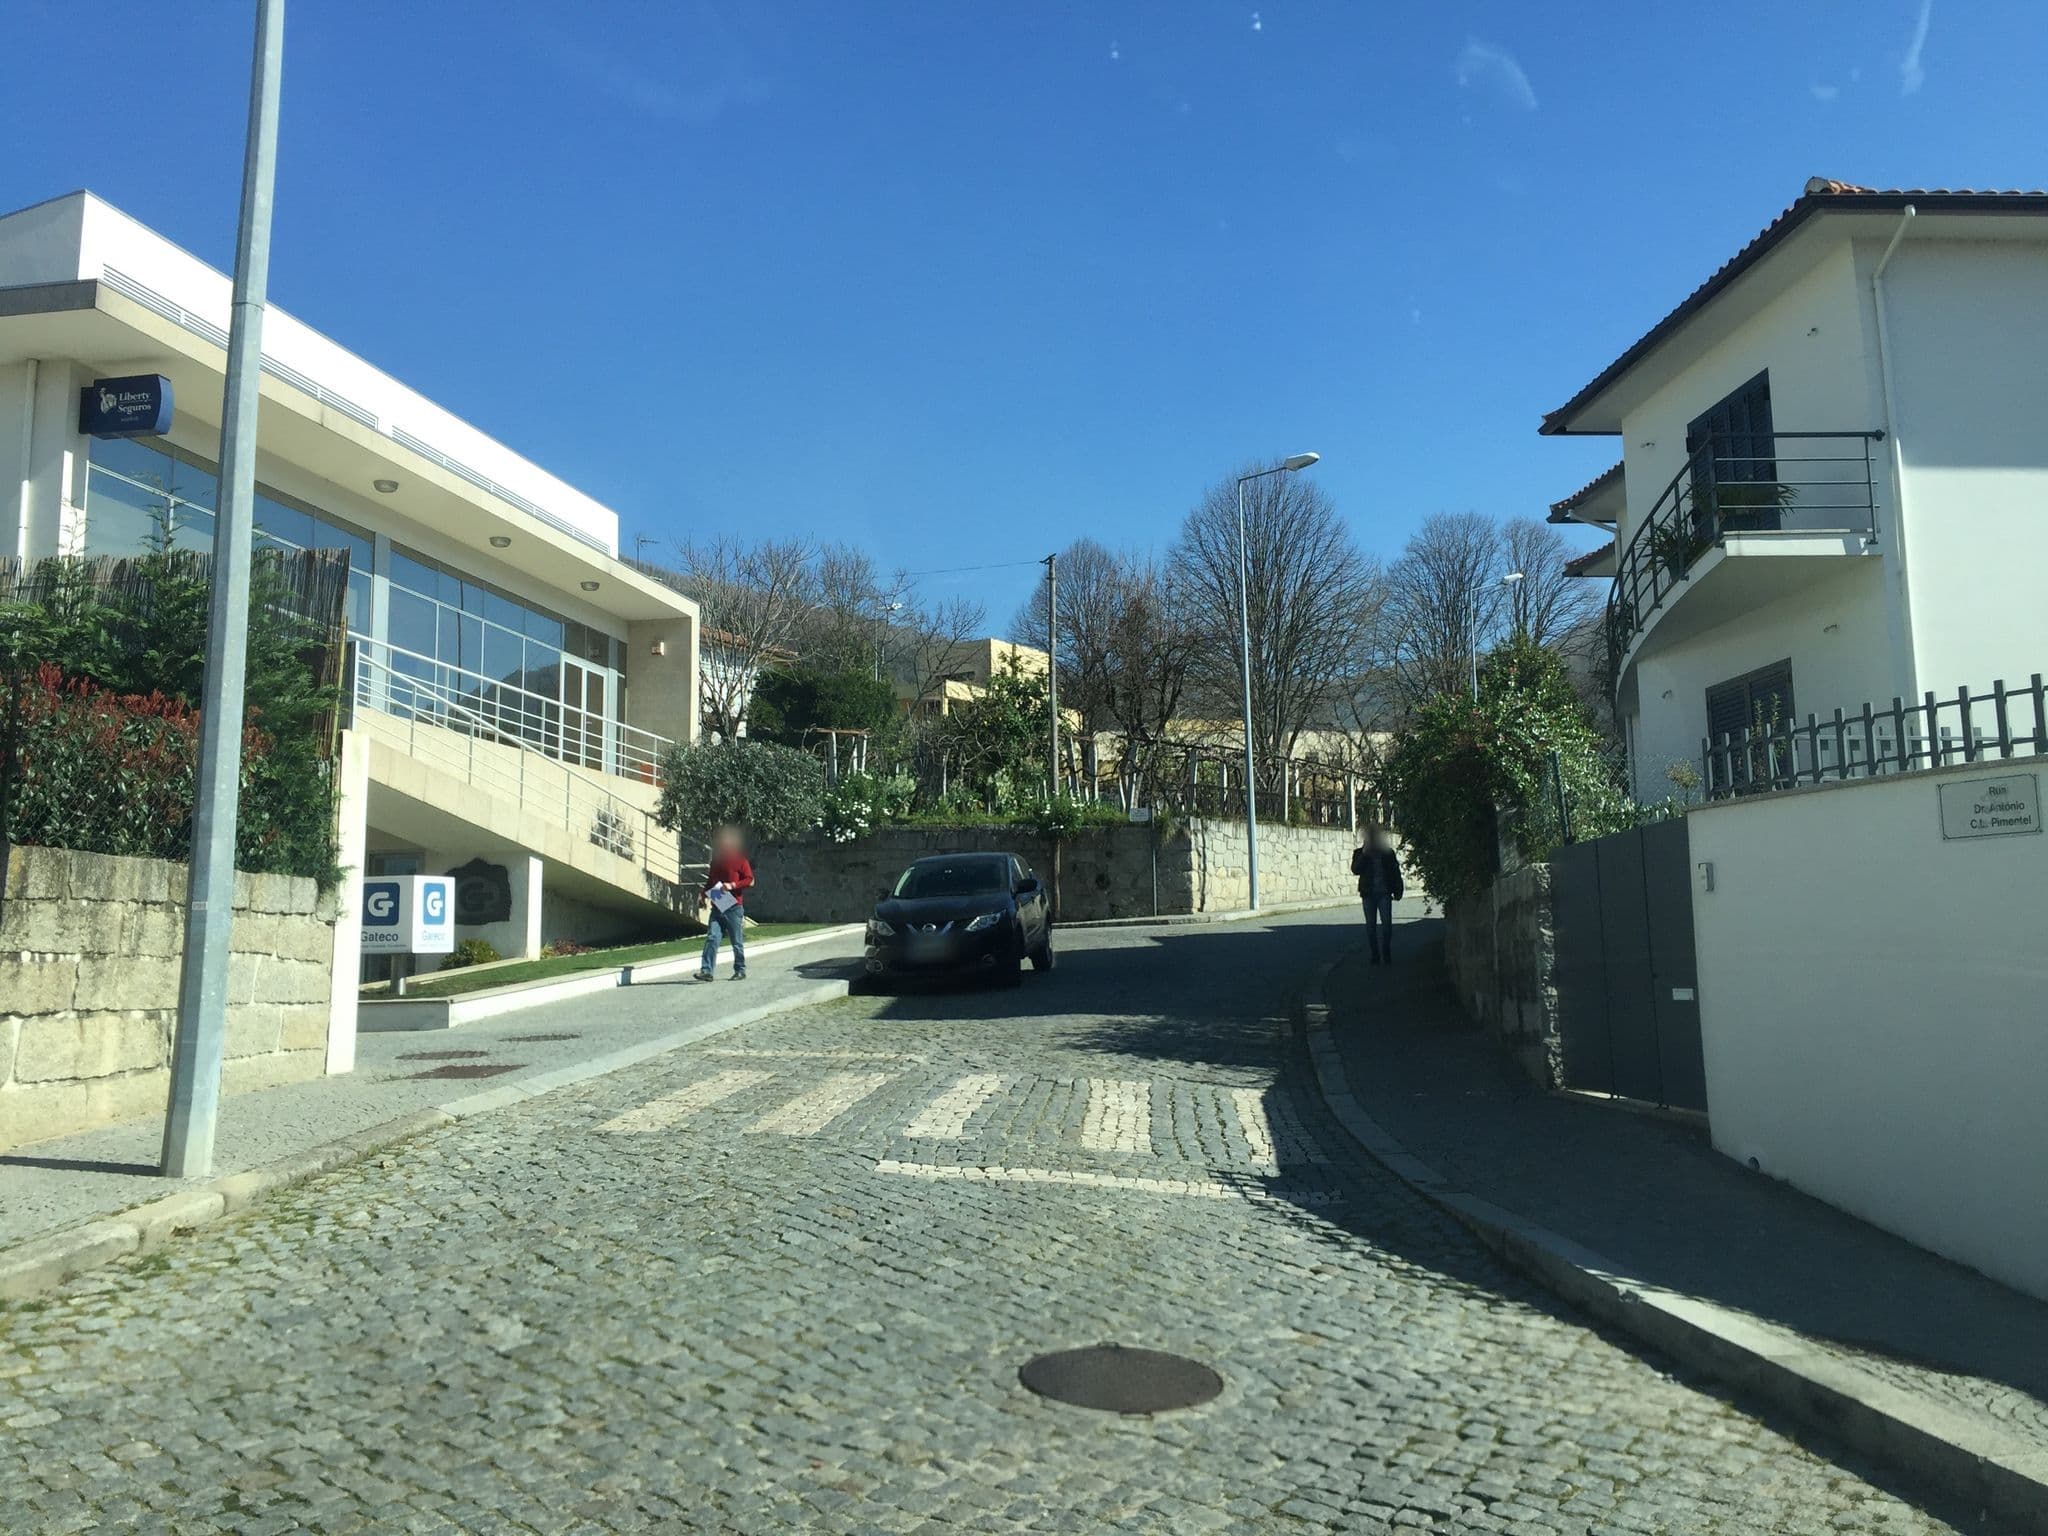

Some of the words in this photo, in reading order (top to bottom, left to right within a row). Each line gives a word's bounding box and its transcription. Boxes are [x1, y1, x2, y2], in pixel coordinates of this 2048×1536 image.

[119, 392, 150, 402] Liberty
[118, 404, 152, 415] Seguros
[1988, 786, 2007, 796] Rua
[1991, 814, 2031, 827] Pimentel
[367, 891, 394, 917] G
[361, 930, 399, 942] Gateco
